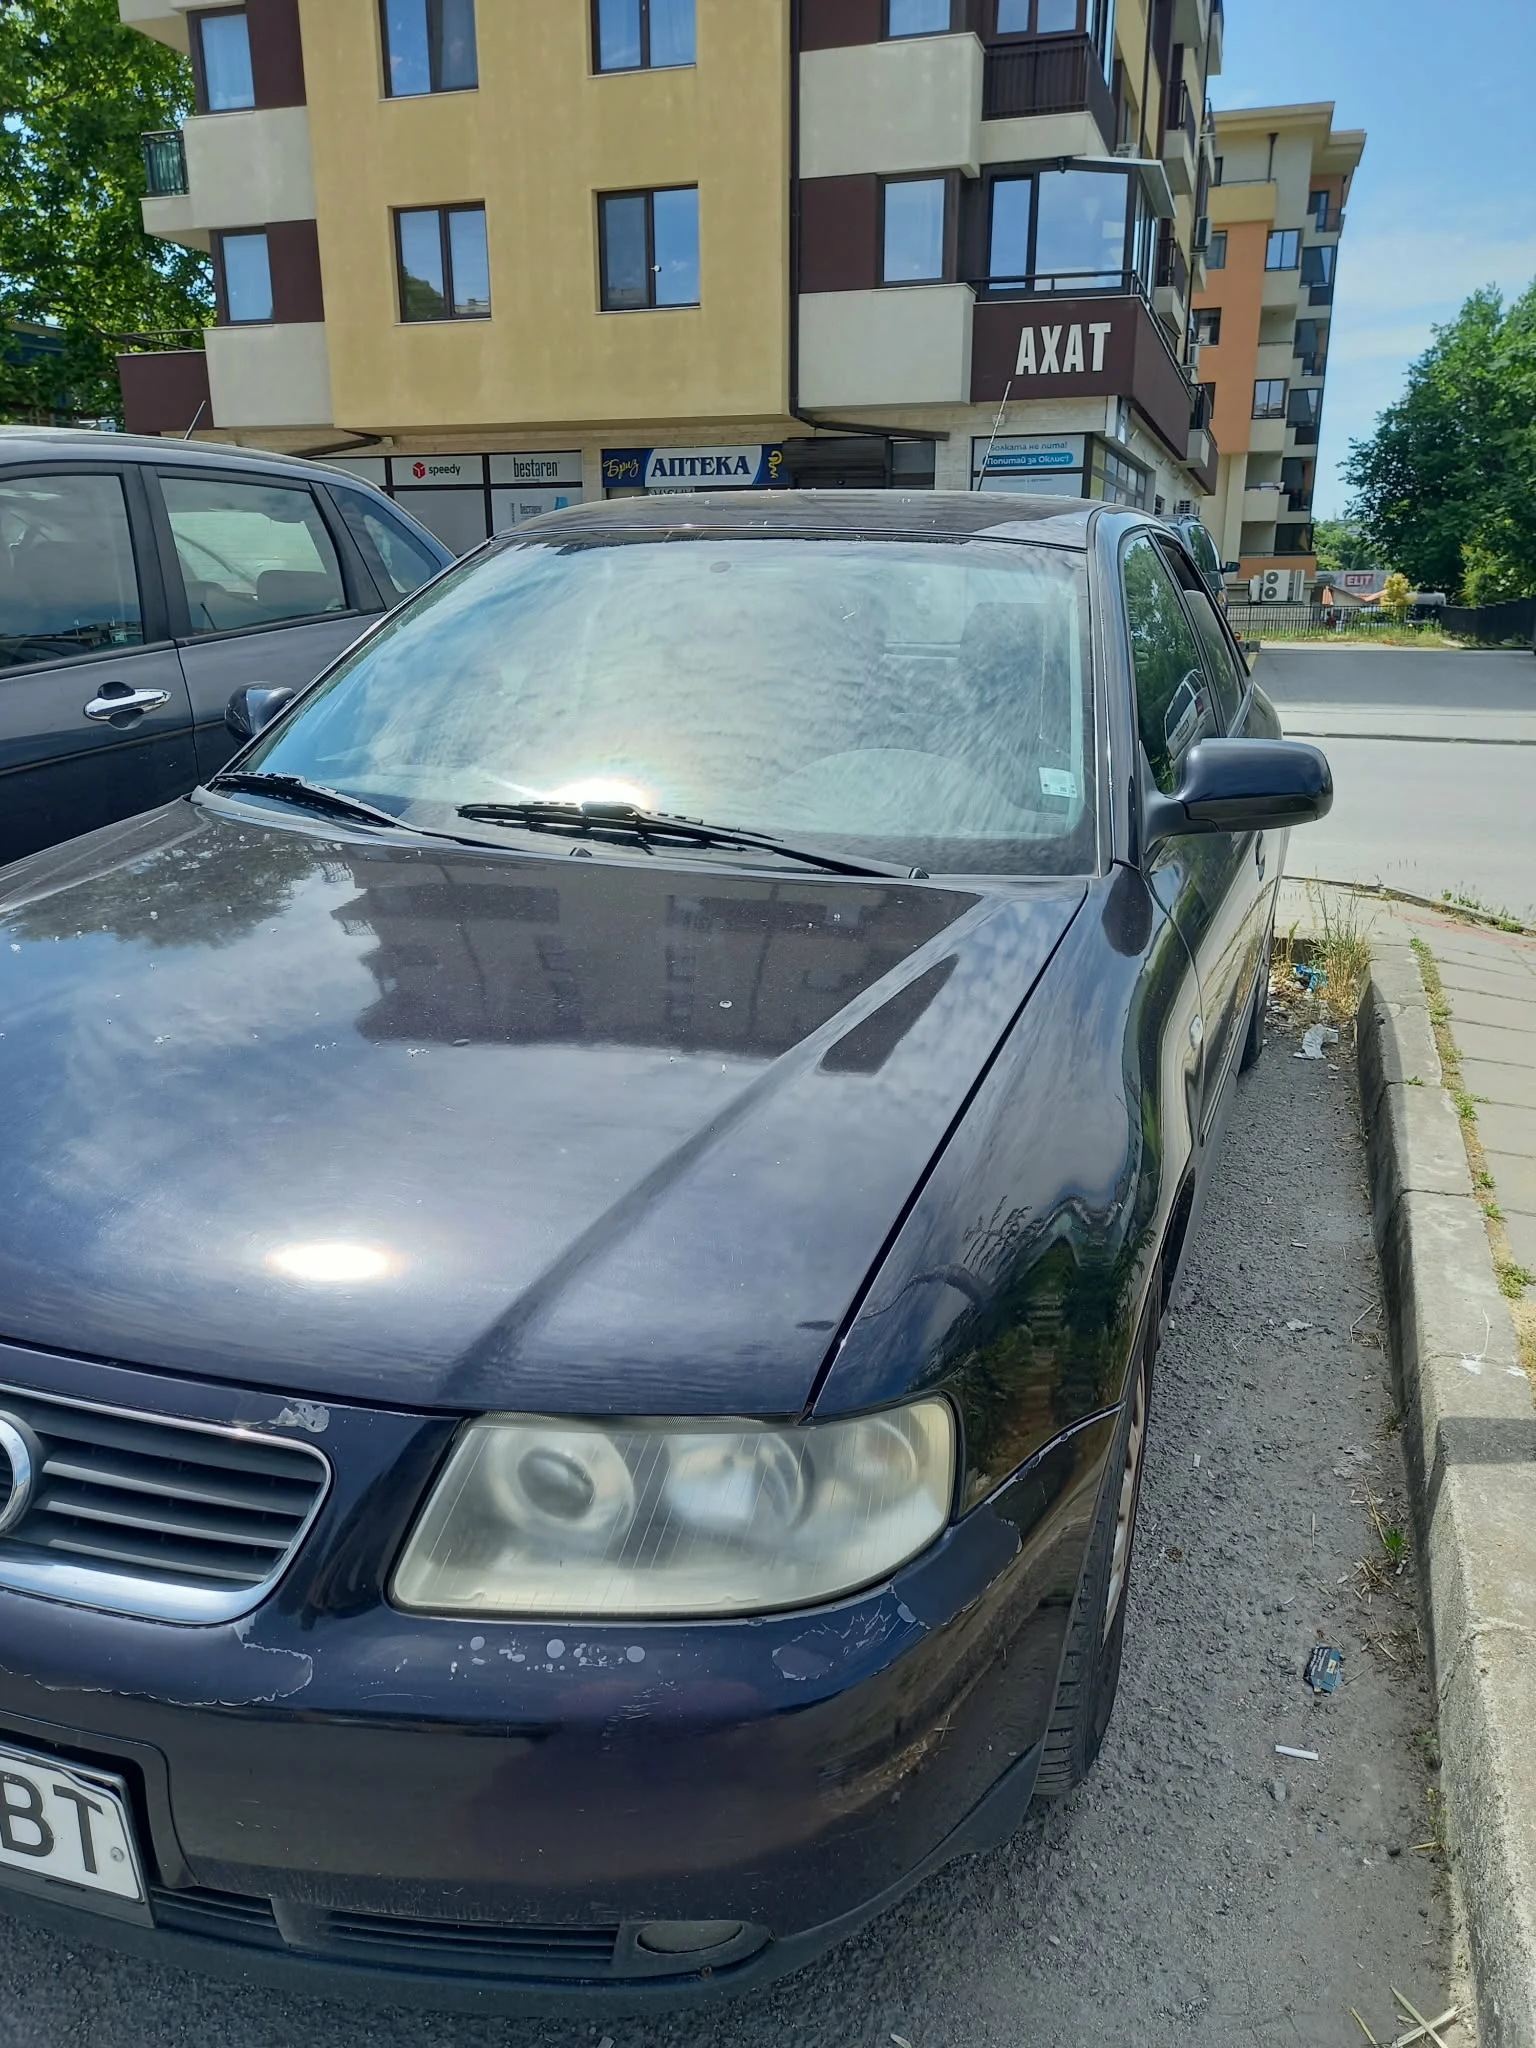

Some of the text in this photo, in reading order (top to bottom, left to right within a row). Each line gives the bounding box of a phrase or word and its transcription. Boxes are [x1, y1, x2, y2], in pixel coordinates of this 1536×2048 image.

[1015, 322, 1112, 376] АХАТ
[1041, 441, 1067, 450] пита!
[513, 457, 558, 478] bestaren
[602, 456, 752, 480] Бриз АПТЕКА
[987, 456, 1027, 465] Попитай
[1027, 457, 1037, 465] за
[428, 464, 461, 476] speedy
[1347, 576, 1372, 585] ELIT
[0, 1771, 104, 1875] BT
